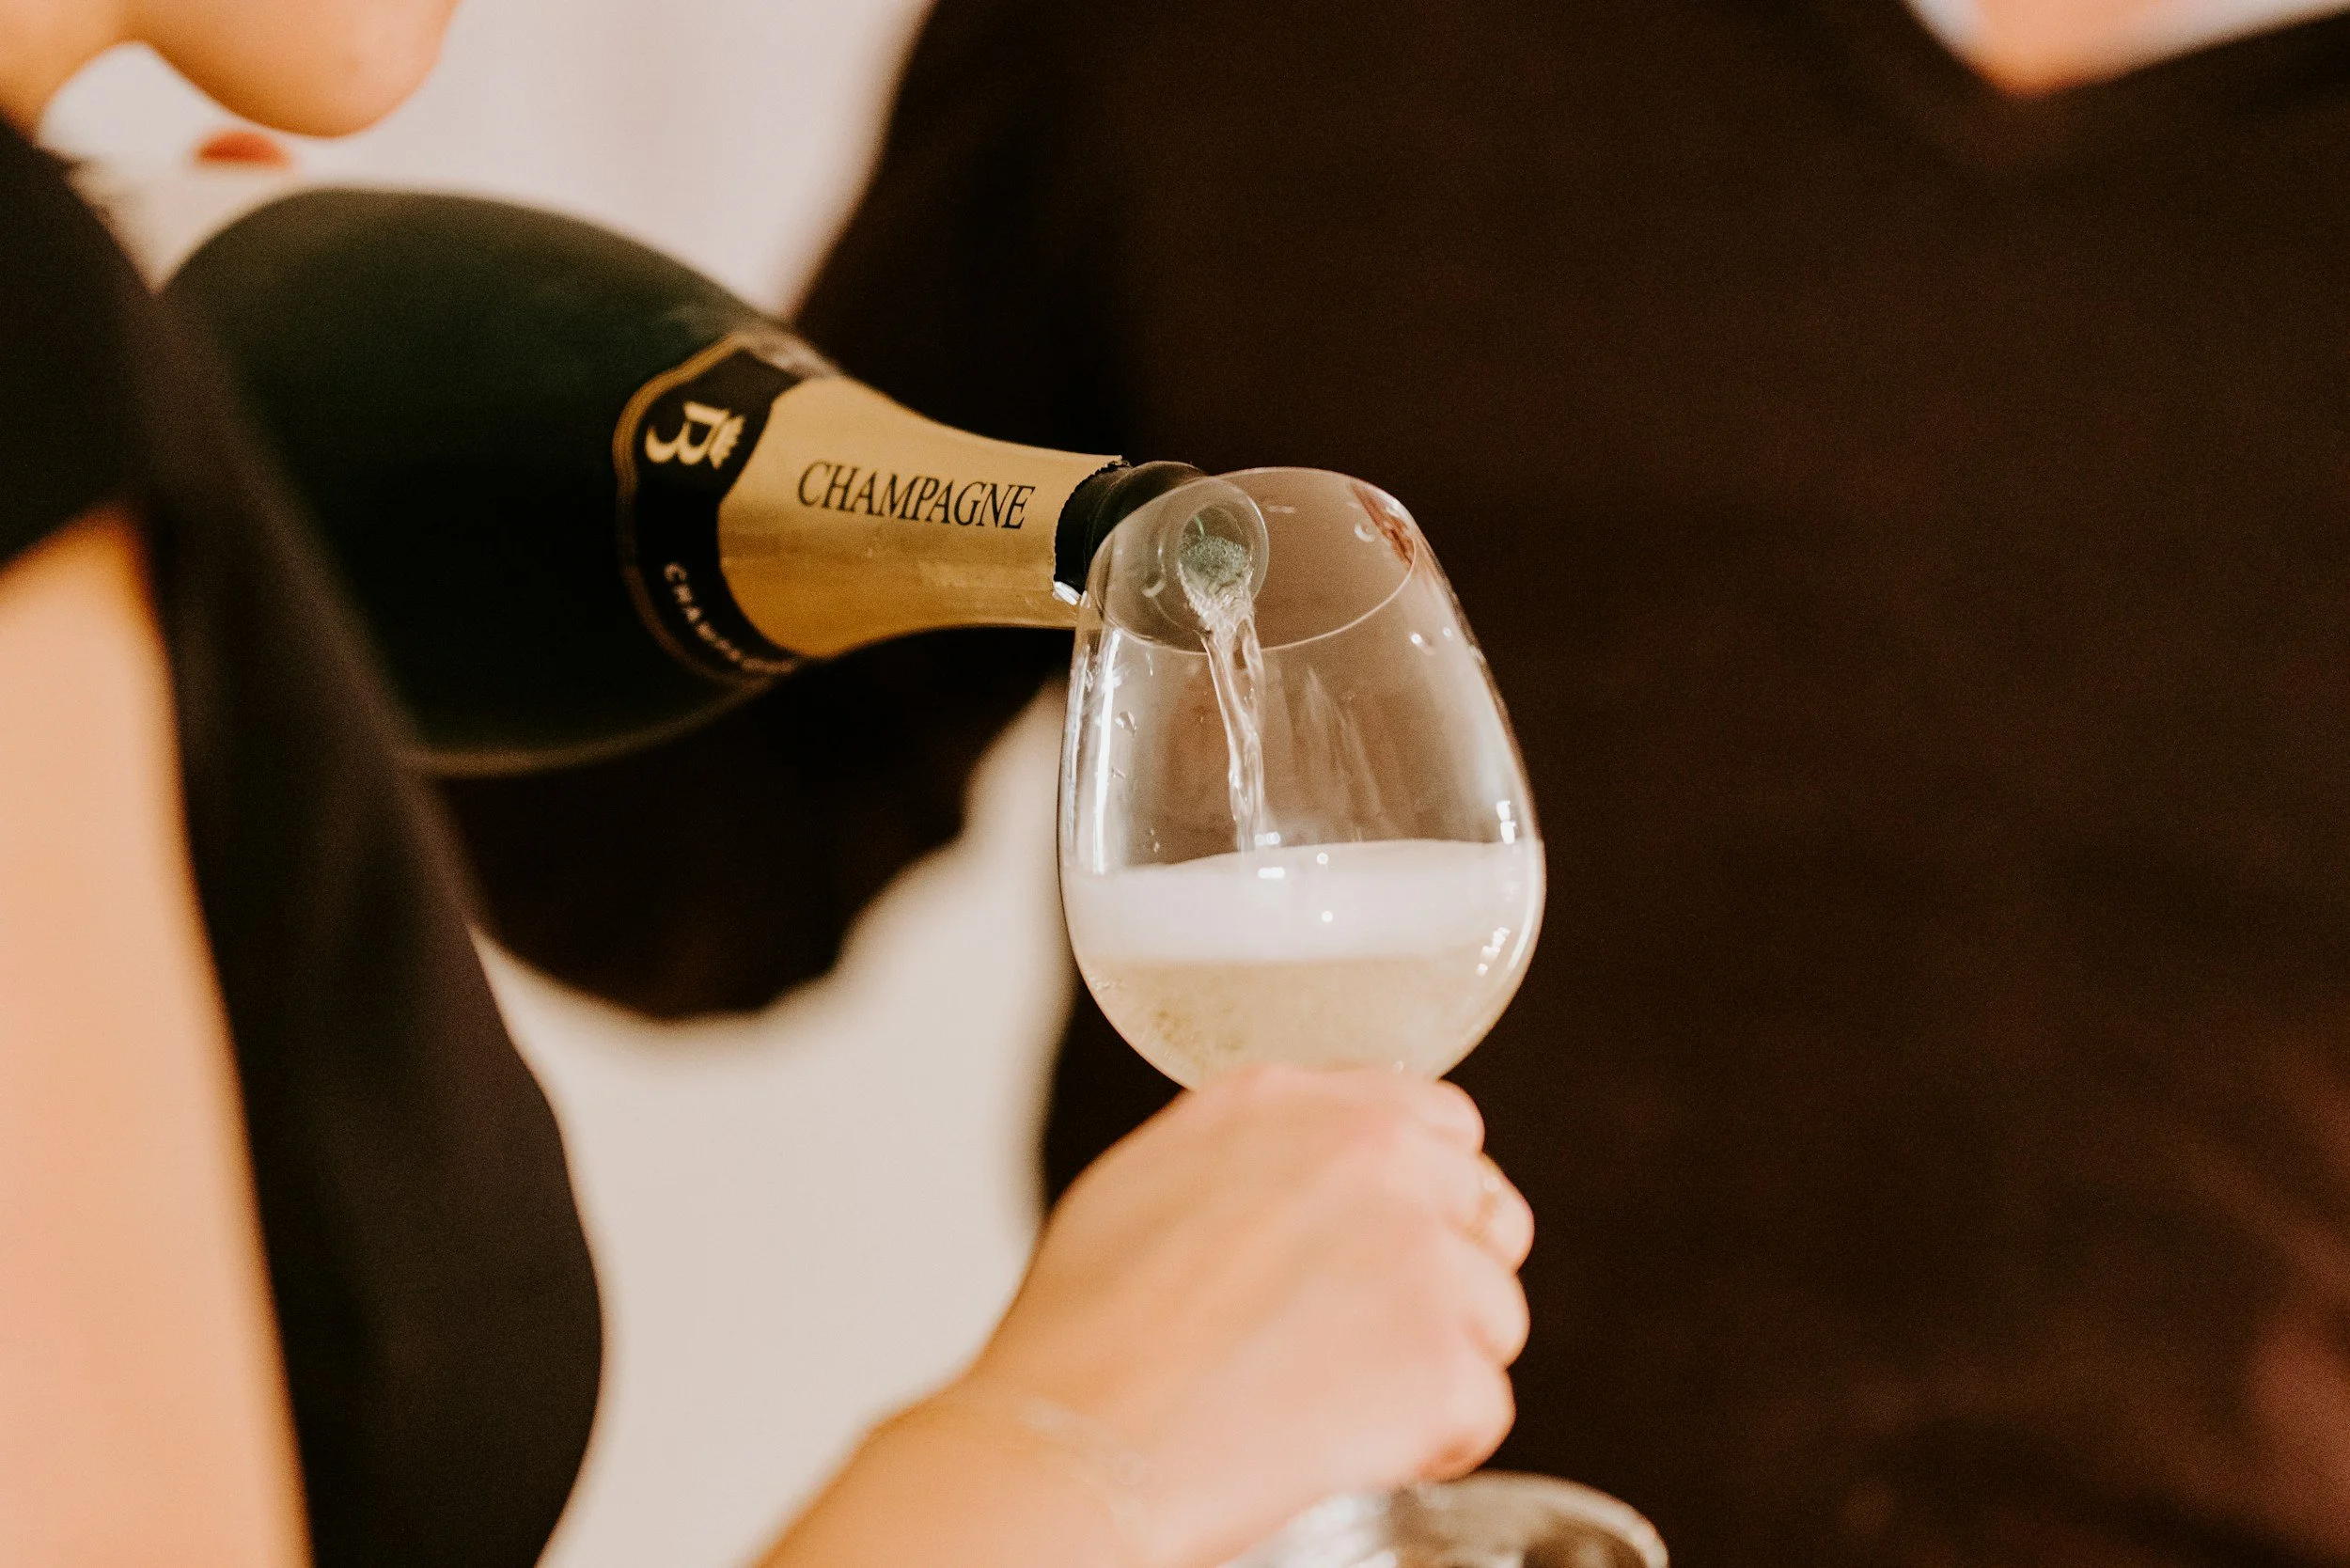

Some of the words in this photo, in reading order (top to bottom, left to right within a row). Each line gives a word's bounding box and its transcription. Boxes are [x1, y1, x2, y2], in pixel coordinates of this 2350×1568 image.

[646, 401, 729, 464] B
[797, 459, 1036, 530] CHAMPAGNE
[664, 563, 795, 674] CHAMPA
